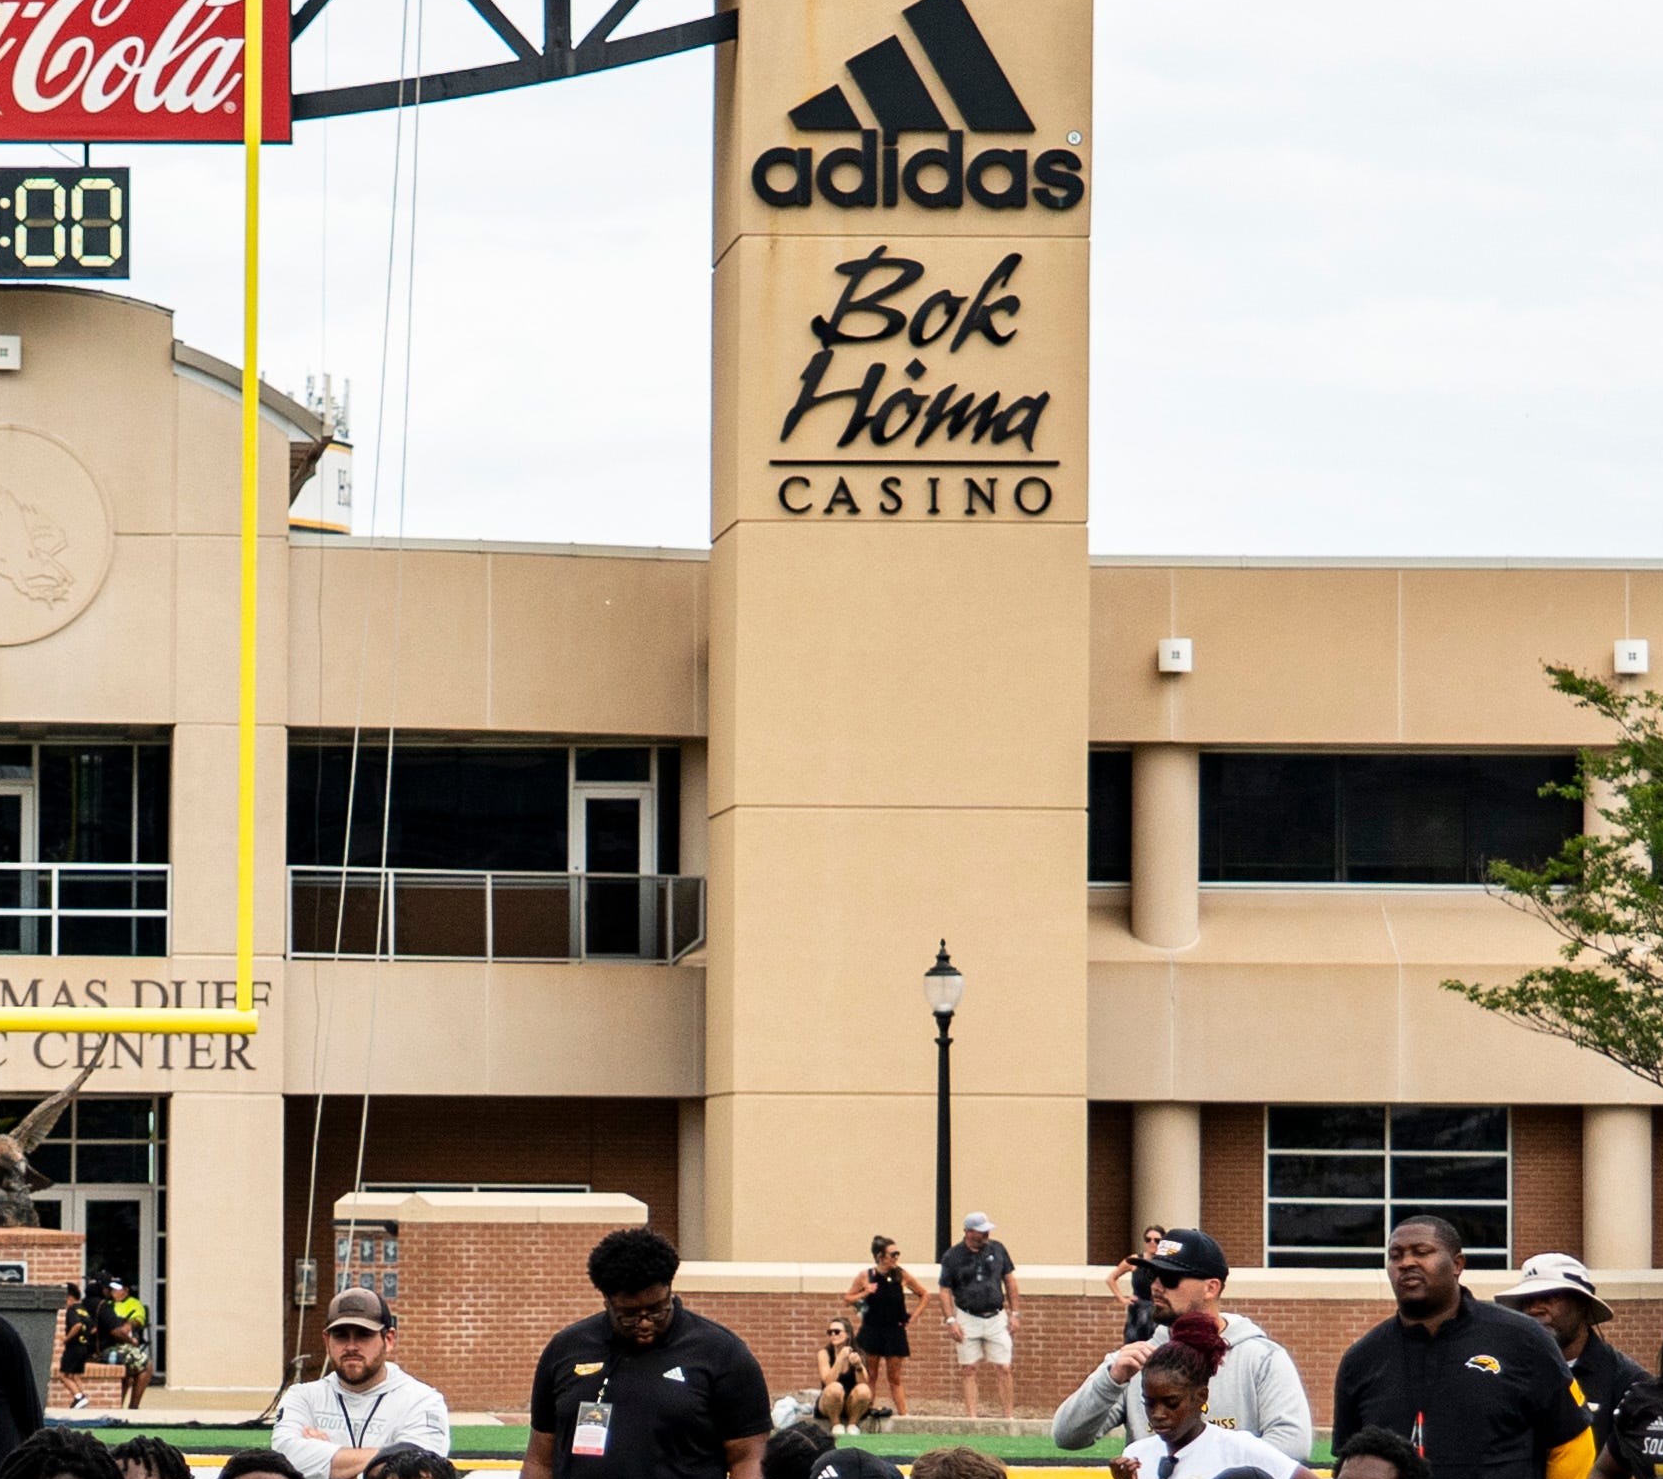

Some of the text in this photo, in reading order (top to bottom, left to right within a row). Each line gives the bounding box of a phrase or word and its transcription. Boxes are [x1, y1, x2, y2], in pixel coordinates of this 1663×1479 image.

[751, 128, 1086, 211] adidas
[810, 244, 1024, 354] Bok
[779, 348, 1051, 453] Homa
[777, 476, 1053, 516] CASINO
[33, 1033, 257, 1073] CENTER
